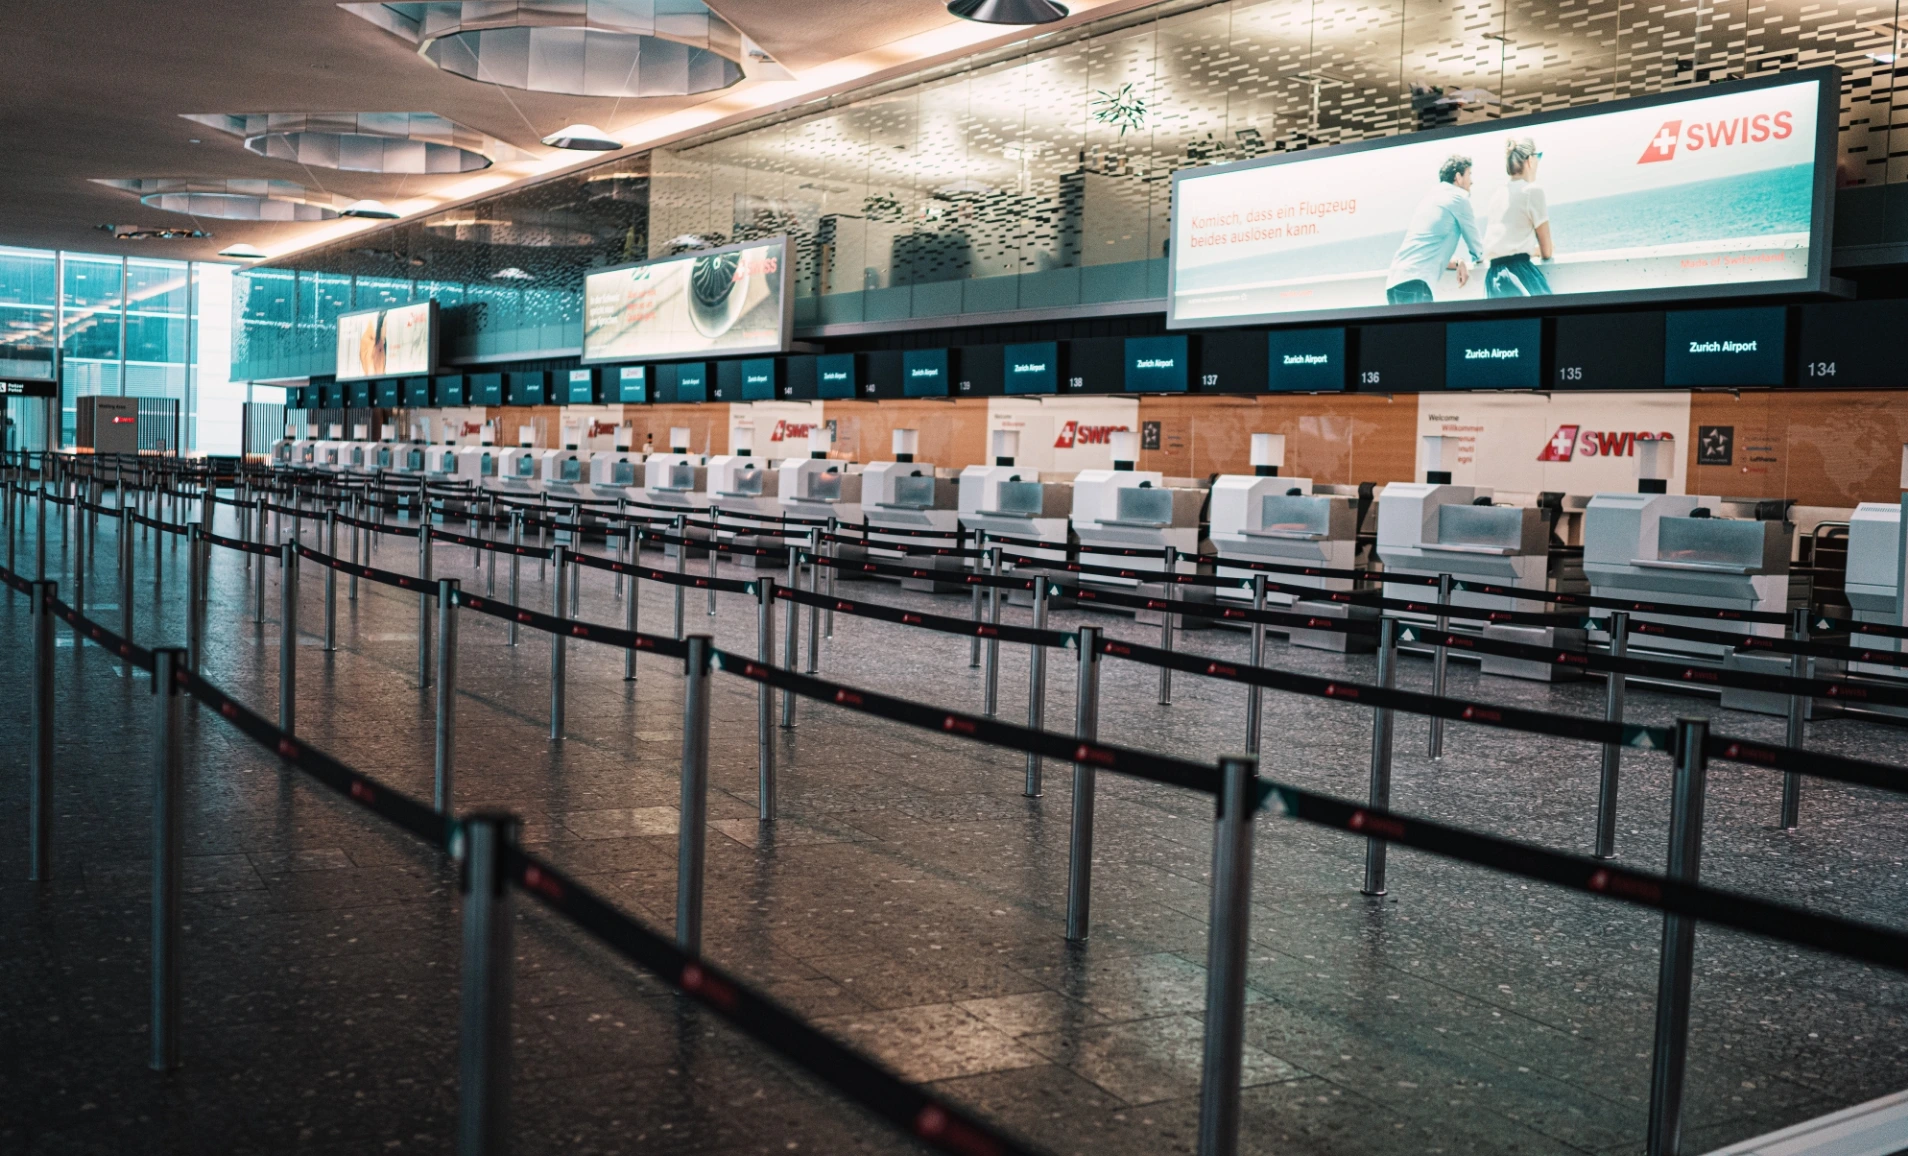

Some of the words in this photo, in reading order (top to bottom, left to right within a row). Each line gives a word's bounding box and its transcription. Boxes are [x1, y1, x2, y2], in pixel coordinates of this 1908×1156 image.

[1686, 111, 1793, 151] SWISS
[1191, 211, 1242, 230] Komisch,
[1246, 208, 1273, 223] dass
[1276, 205, 1295, 219] ein
[1299, 198, 1357, 218] Flugzeug
[1191, 234, 1227, 248] beides
[1230, 227, 1282, 244] auslösen
[1286, 223, 1320, 237] kann.
[1680, 259, 1708, 269] Made
[1710, 256, 1720, 266] of
[1723, 251, 1785, 266] Switzerland
[1689, 341, 1721, 353] Zurich
[1722, 340, 1757, 353] Airport
[1283, 354, 1304, 365] Zurich
[1304, 354, 1328, 365] Airport
[1465, 349, 1490, 359] Zurich
[1491, 348, 1519, 360] Airport
[1014, 364, 1029, 373] Zurich
[1029, 363, 1046, 373] Airport
[1137, 359, 1154, 369] Zurich
[1154, 359, 1174, 369] Airport
[1808, 362, 1836, 376] 134
[1361, 371, 1380, 383] 136
[1559, 367, 1582, 380] 135
[1069, 377, 1083, 388] 138
[1202, 375, 1218, 386] 137
[1441, 424, 1484, 432] Willkommen
